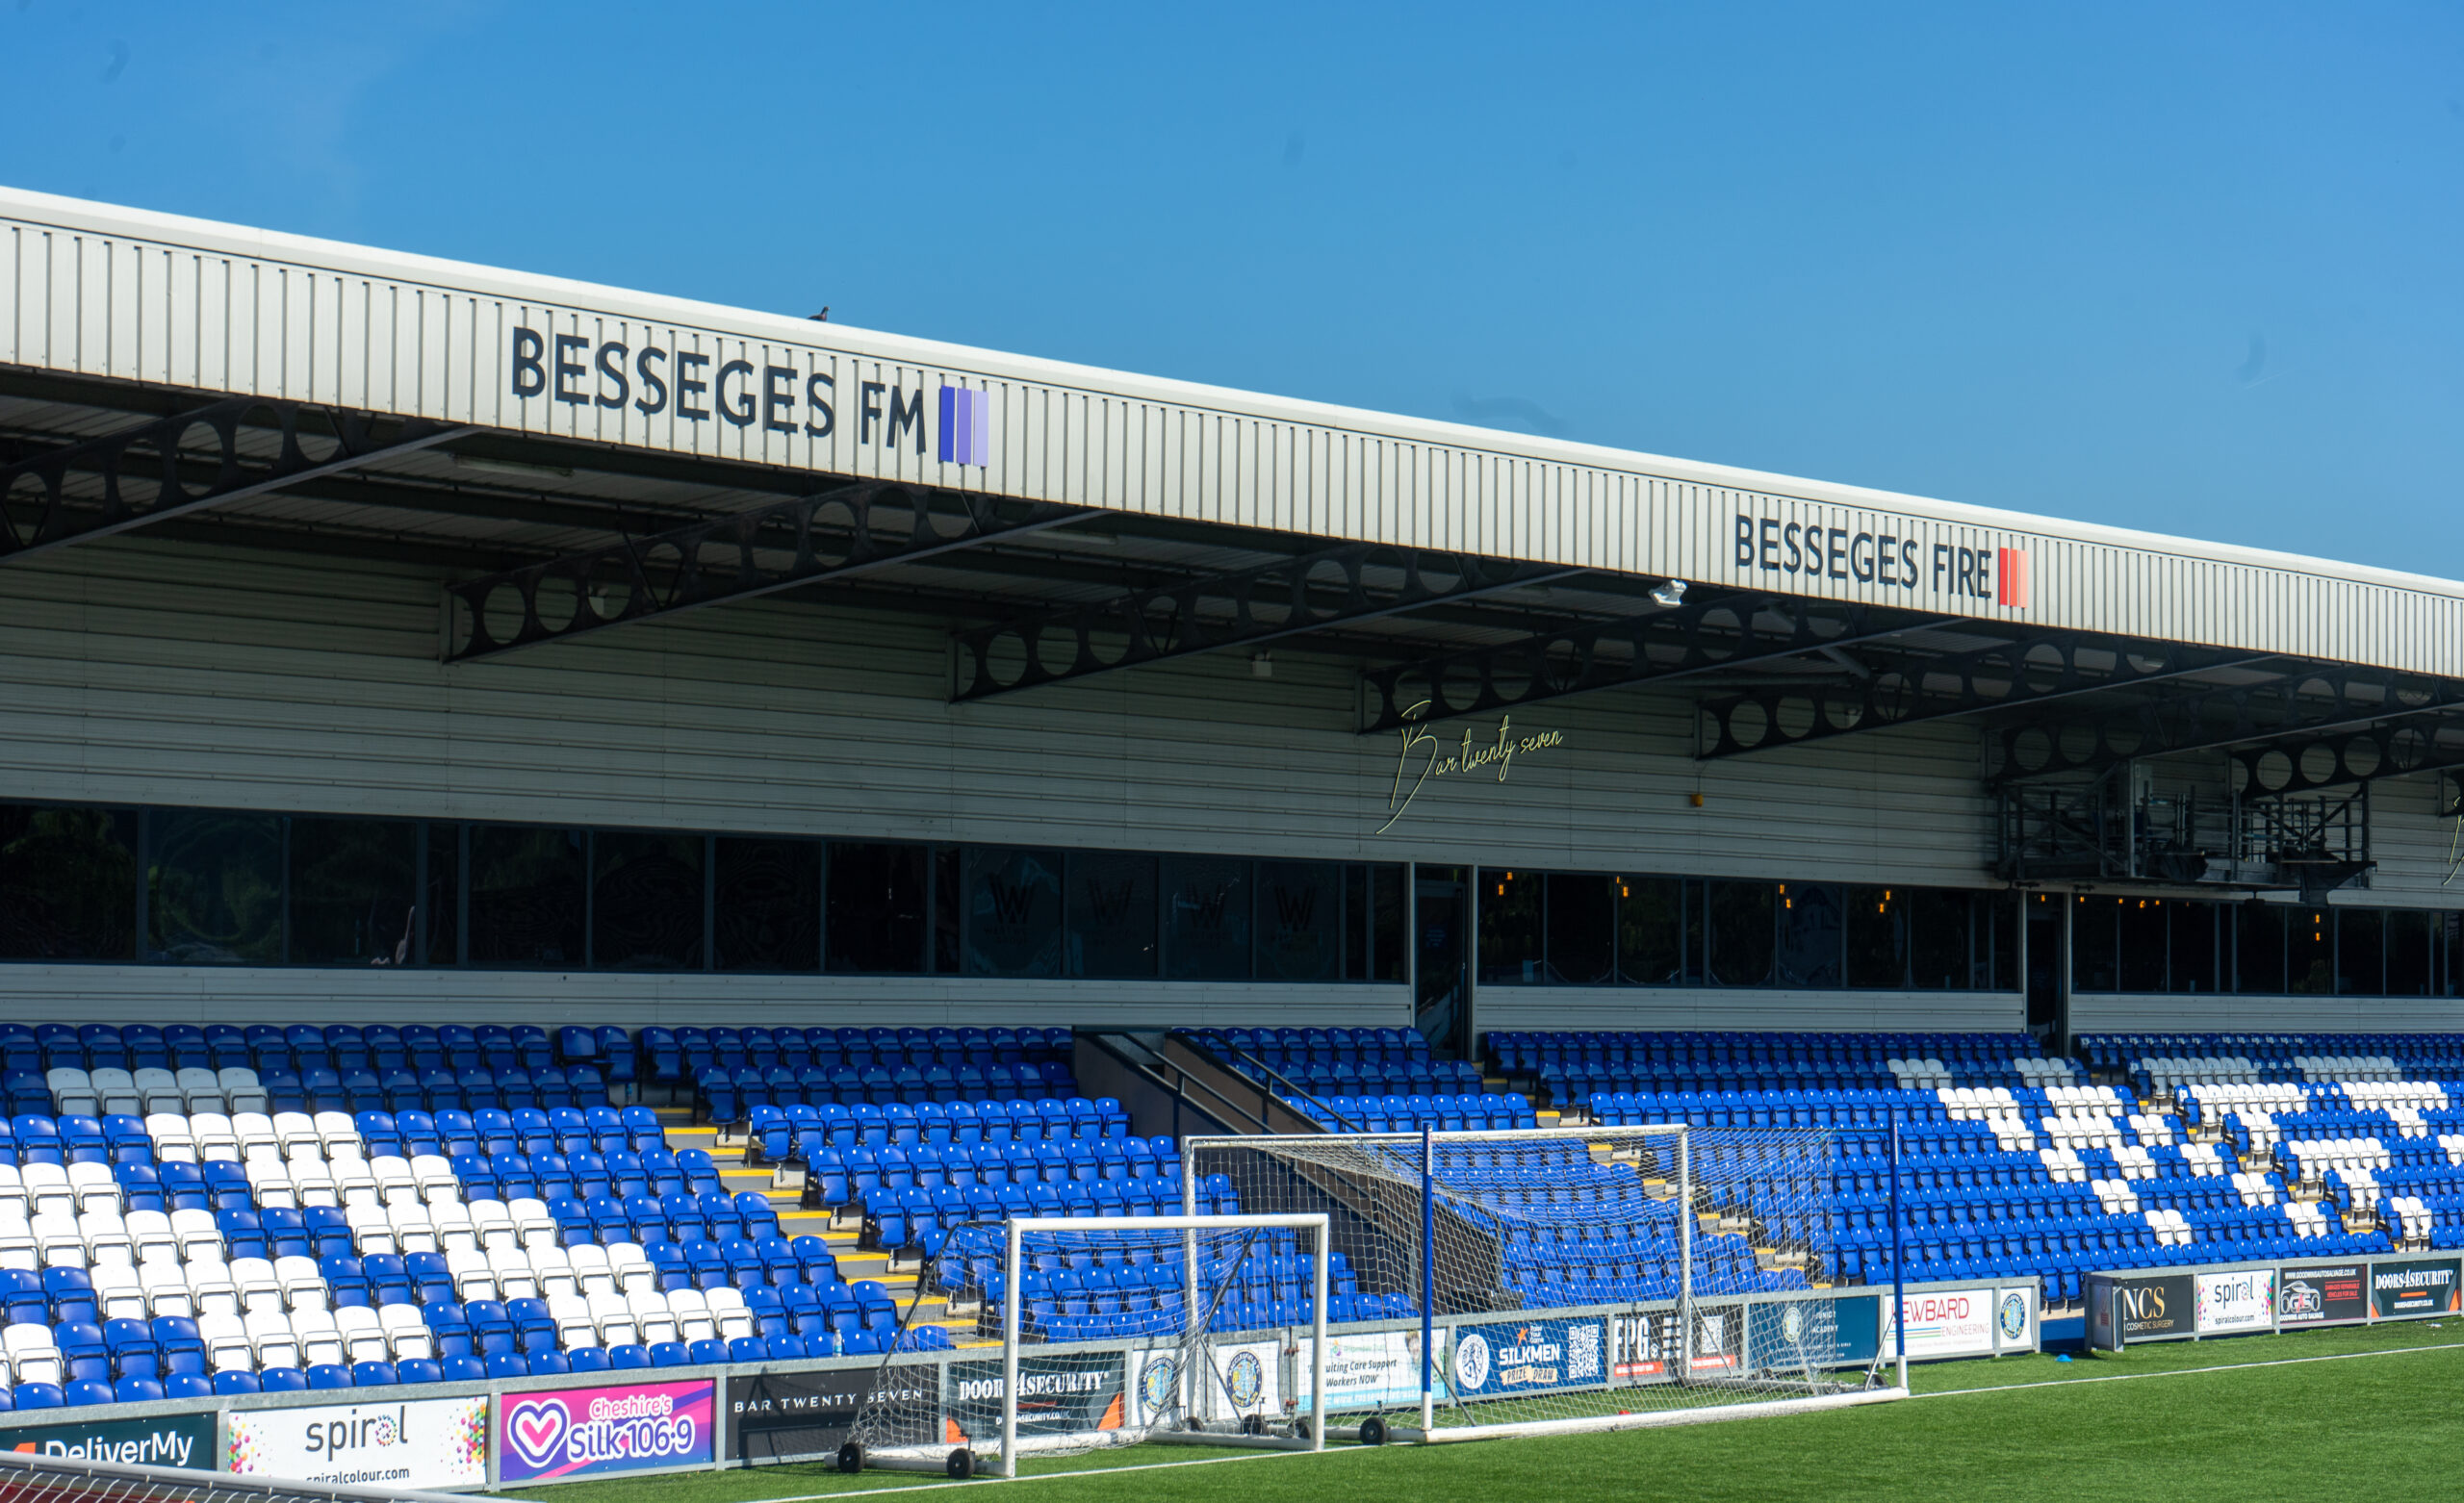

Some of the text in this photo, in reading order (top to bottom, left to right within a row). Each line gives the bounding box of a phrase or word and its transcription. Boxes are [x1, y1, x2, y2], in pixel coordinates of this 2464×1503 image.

[512, 325, 927, 454] BESSEGES FM
[1734, 513, 1992, 599] BESSEGES FIRE
[1461, 714, 1517, 782] twenty
[1520, 729, 1564, 754] seven
[2215, 1275, 2254, 1310] spiral
[2374, 1269, 2451, 1289] DOORS4SECURITY
[2124, 1286, 2166, 1320] NCS
[1941, 1323, 1989, 1337] ENGINEERING
[2127, 1321, 2151, 1331] COSMETIC
[2152, 1319, 2174, 1329] SURGERY
[1349, 1362, 1367, 1371] Care
[1369, 1359, 1397, 1371] Support
[1499, 1343, 1560, 1365] SILKMEN
[959, 1370, 1104, 1400] DOOR4SECURITY
[1326, 1376, 1357, 1387] Workers
[1507, 1368, 1553, 1381] PRIZE DRAW
[590, 1395, 672, 1418] Cheshire's
[734, 1388, 923, 1413] BAR TWENTY SEVEN
[305, 1405, 408, 1462] spiral
[569, 1423, 623, 1459] Silk
[44, 1430, 193, 1466] DeliverMy
